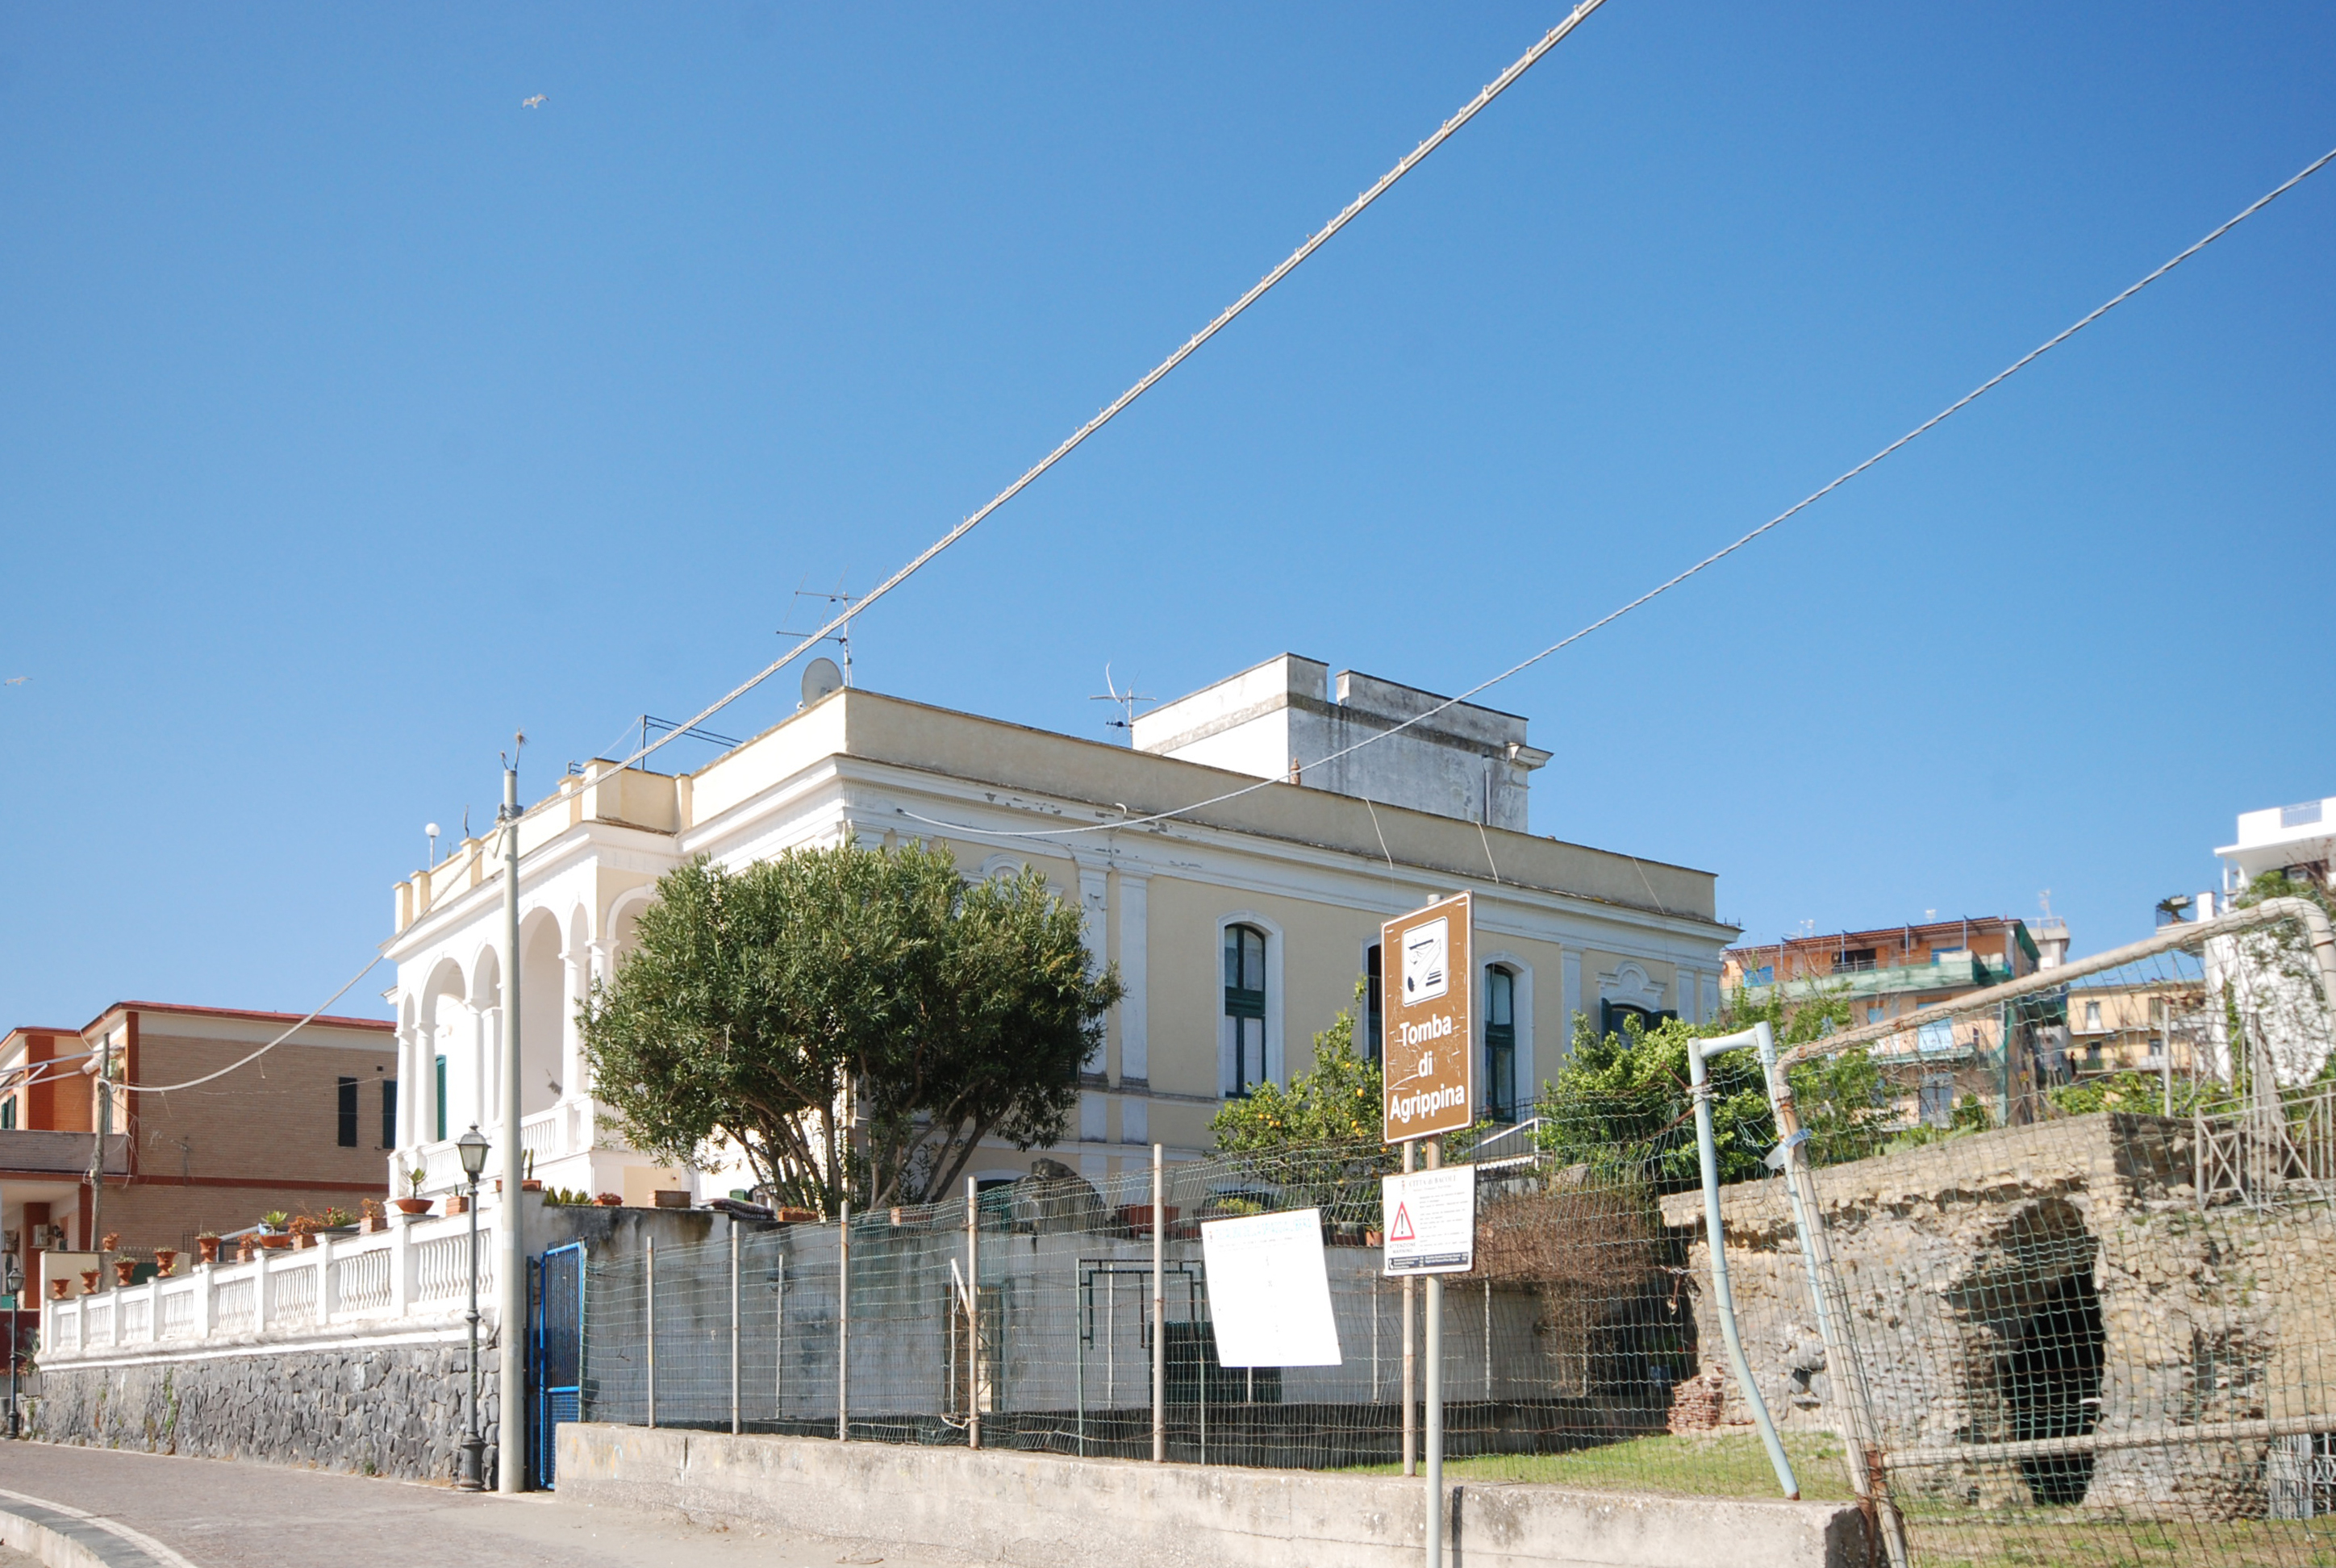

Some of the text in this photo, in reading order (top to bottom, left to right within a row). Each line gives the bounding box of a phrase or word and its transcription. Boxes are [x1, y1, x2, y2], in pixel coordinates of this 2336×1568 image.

[1400, 1014, 1452, 1046] Tomba
[1419, 1051, 1433, 1078] di
[1390, 1083, 1465, 1124] Agrippina
[1435, 1174, 1456, 1184] BACOLI
